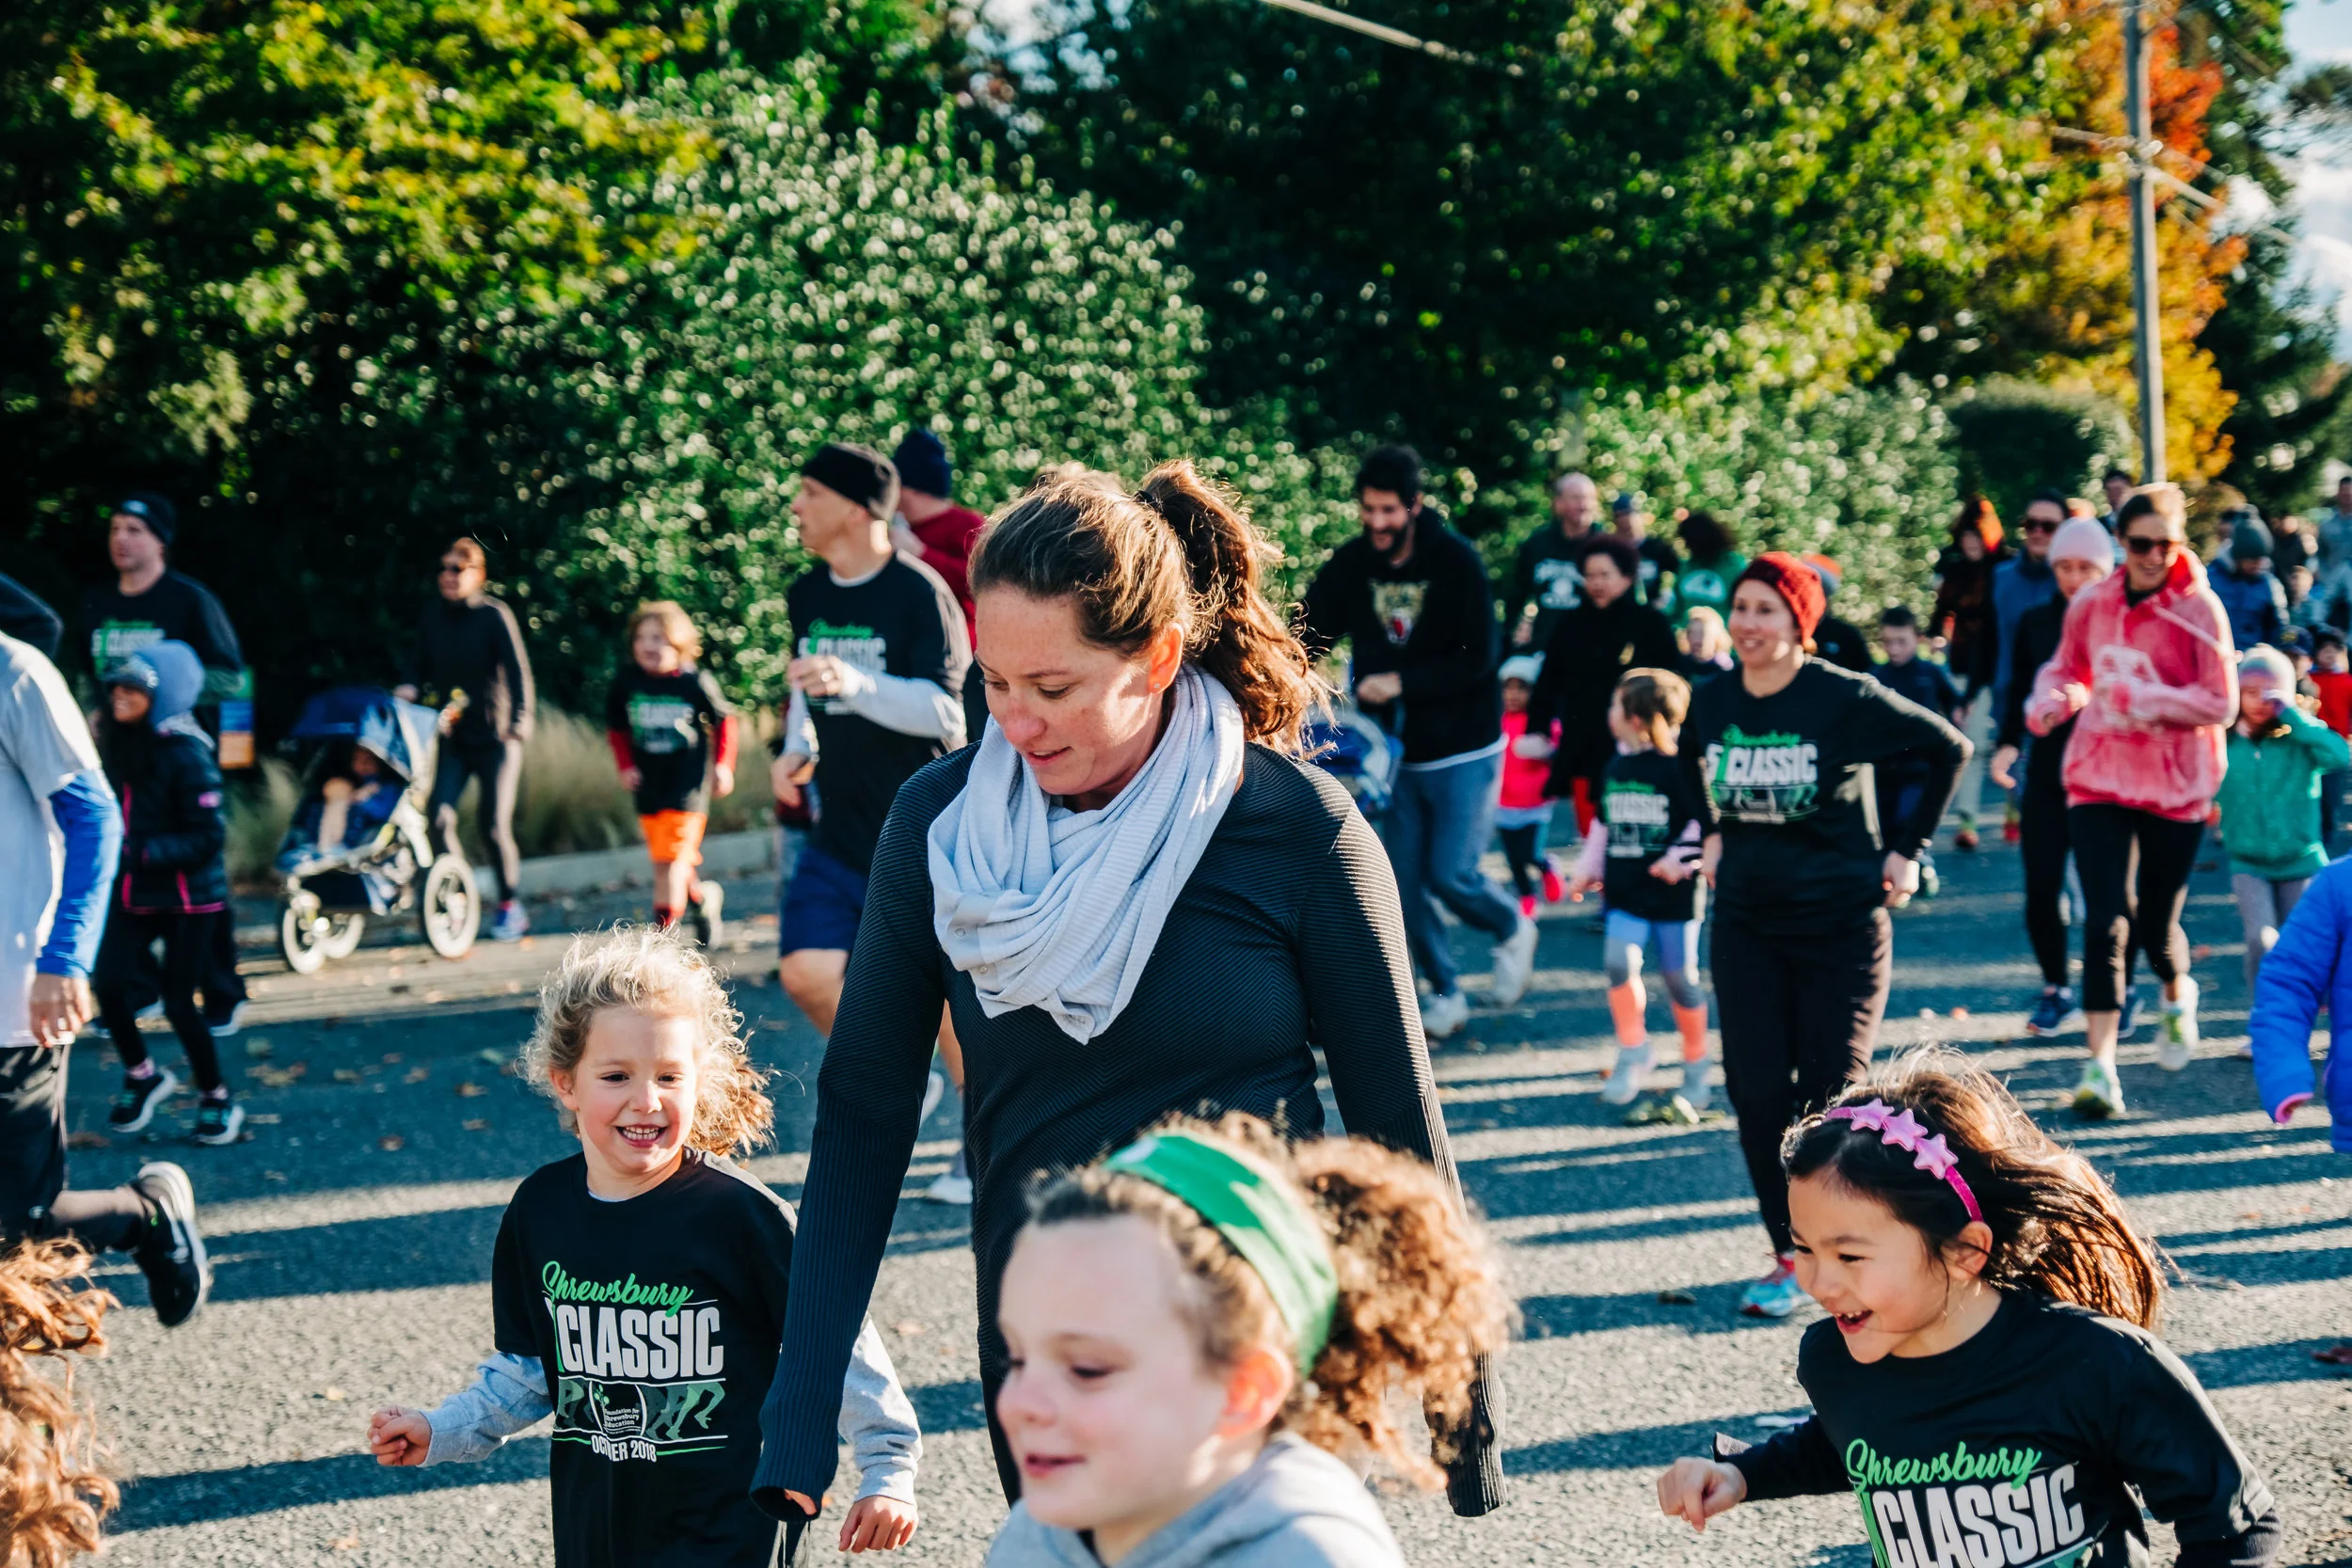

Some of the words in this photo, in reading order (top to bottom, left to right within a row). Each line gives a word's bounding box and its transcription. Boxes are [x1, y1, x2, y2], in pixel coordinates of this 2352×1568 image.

[542, 1260, 694, 1318] Shrewsbury
[556, 1304, 724, 1380] CLASSIC
[629, 1439, 657, 1463] 2018
[1845, 1438, 2042, 1494] Shrewsbury
[1871, 1464, 2086, 1568] CLASSIC
